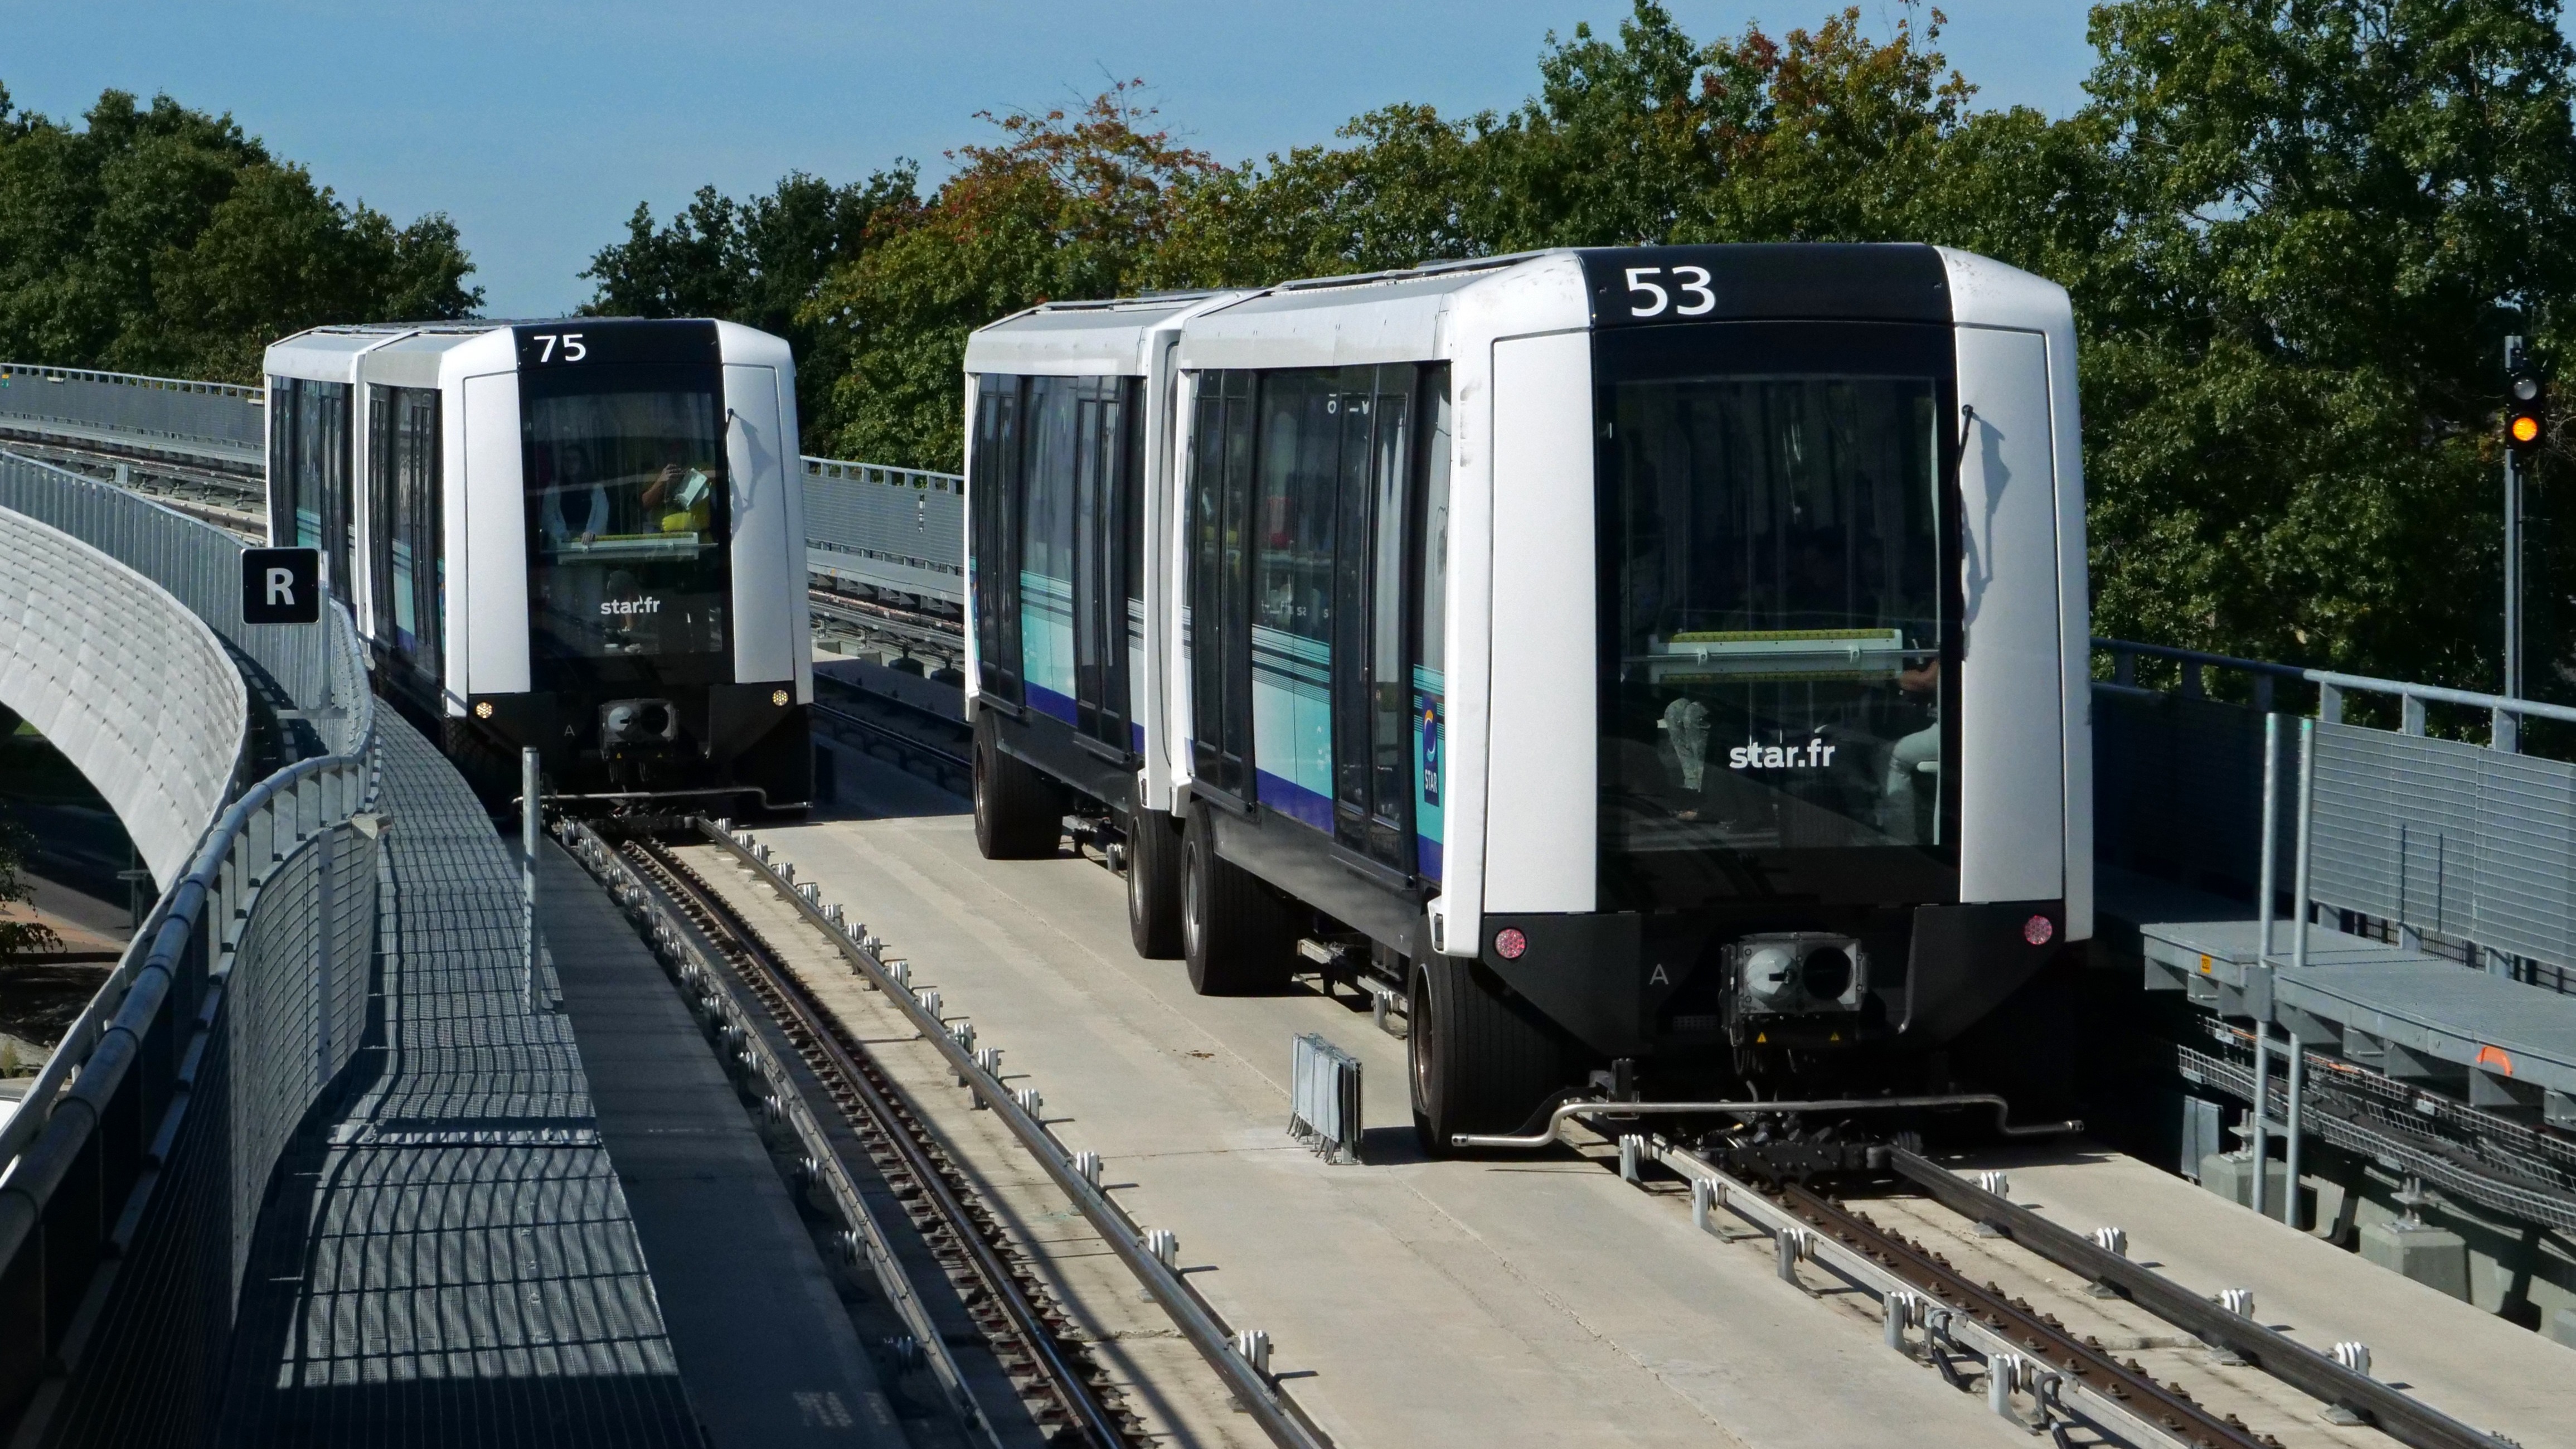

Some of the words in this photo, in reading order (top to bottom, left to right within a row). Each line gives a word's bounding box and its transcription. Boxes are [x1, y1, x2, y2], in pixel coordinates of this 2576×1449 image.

[1625, 265, 1716, 317] 53
[533, 333, 586, 362] 75
[266, 567, 295, 605] R
[600, 596, 660, 614] star.fr
[564, 724, 575, 736] A
[1729, 738, 1835, 768] star.fr
[1425, 769, 1438, 794] STAR
[1650, 963, 1668, 985] A
